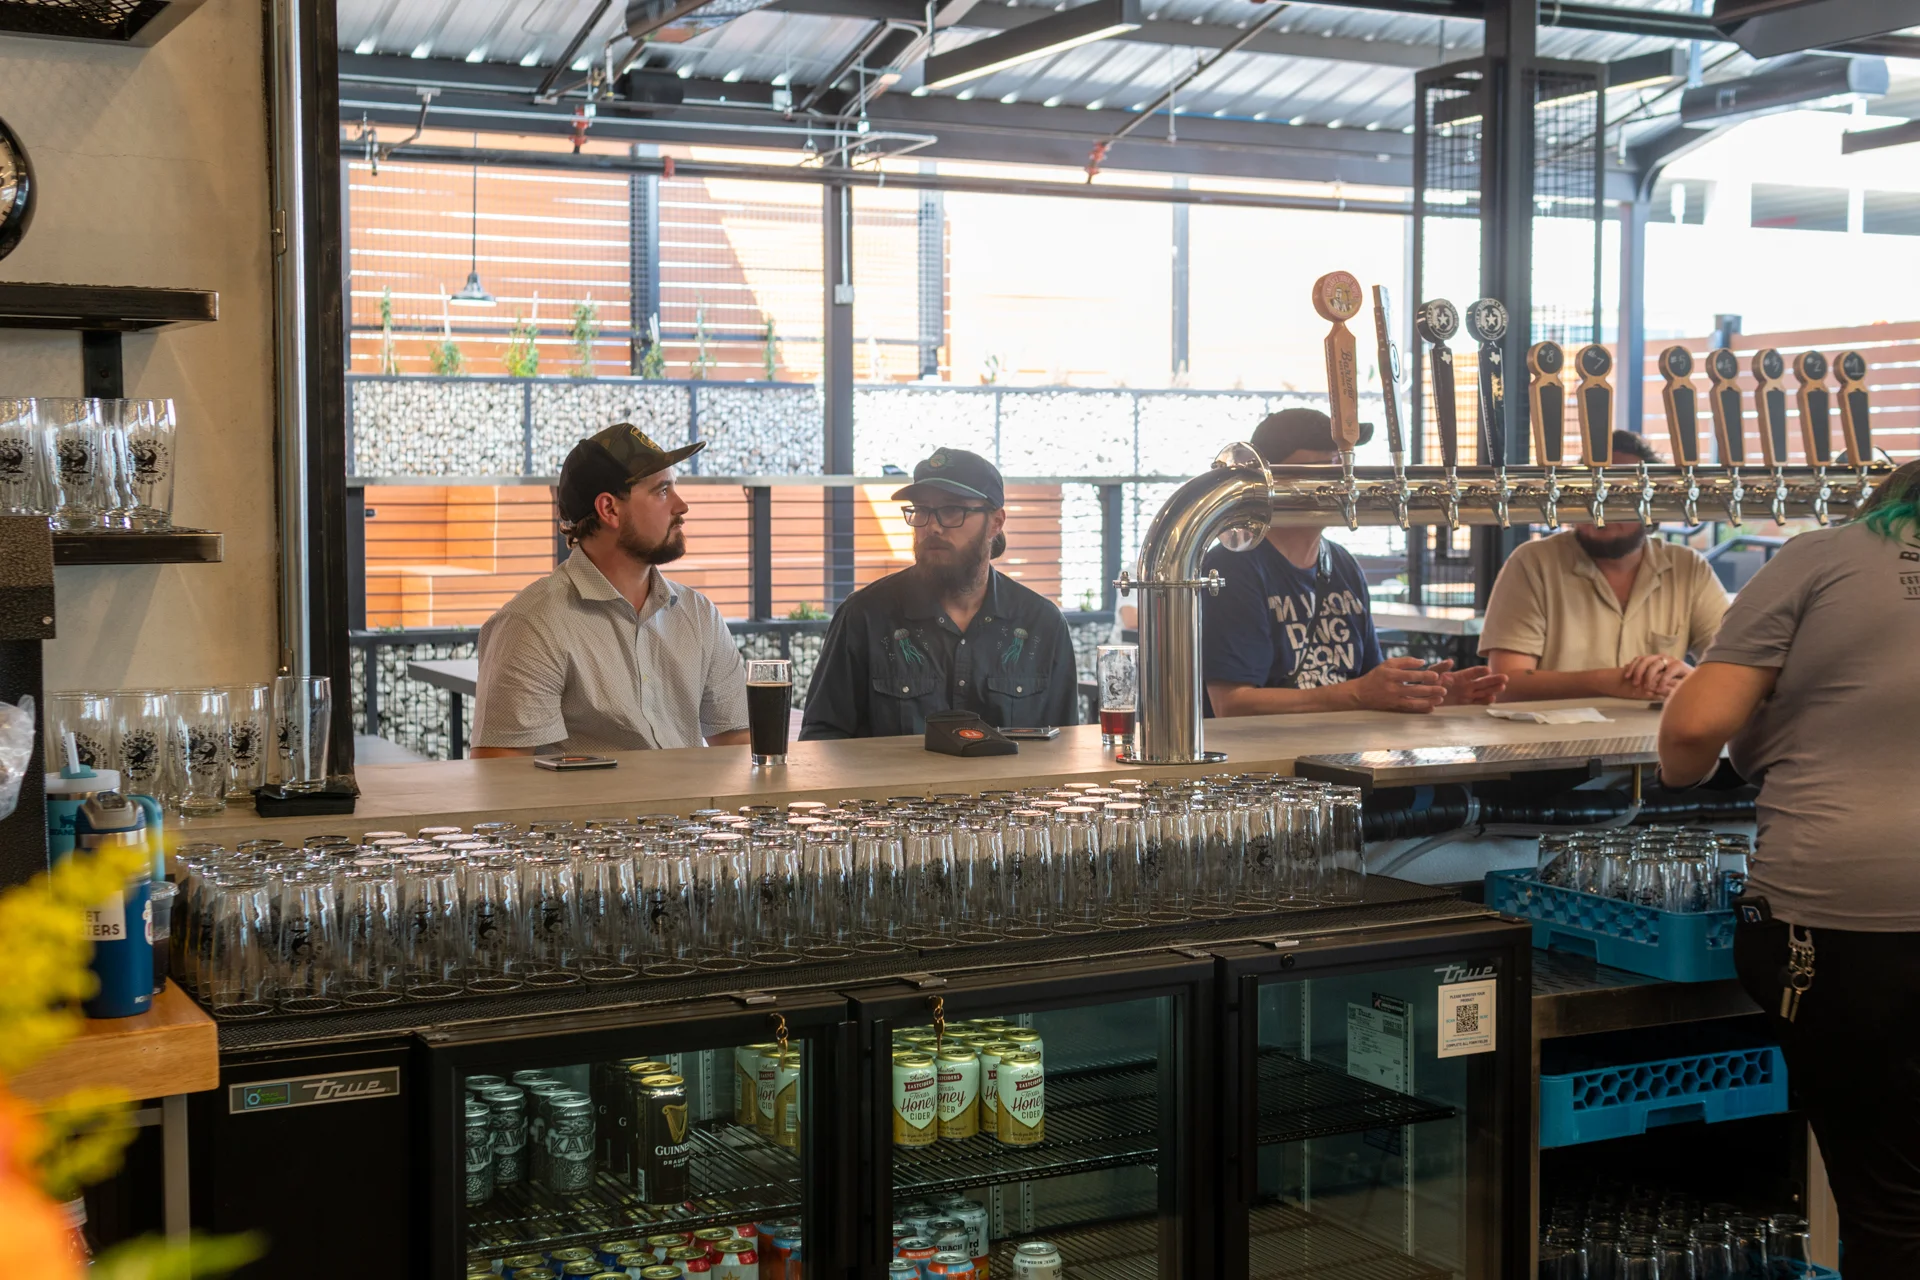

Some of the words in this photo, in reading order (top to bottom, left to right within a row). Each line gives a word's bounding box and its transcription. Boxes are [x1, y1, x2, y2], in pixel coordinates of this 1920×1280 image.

[1340, 348, 1356, 403] Barrow
[227, 757, 260, 771] BREWING
[937, 1090, 966, 1107] oney
[909, 1111, 931, 1121] CIDER
[1021, 1110, 1041, 1120] CIDER
[654, 1140, 690, 1156] GUINNE
